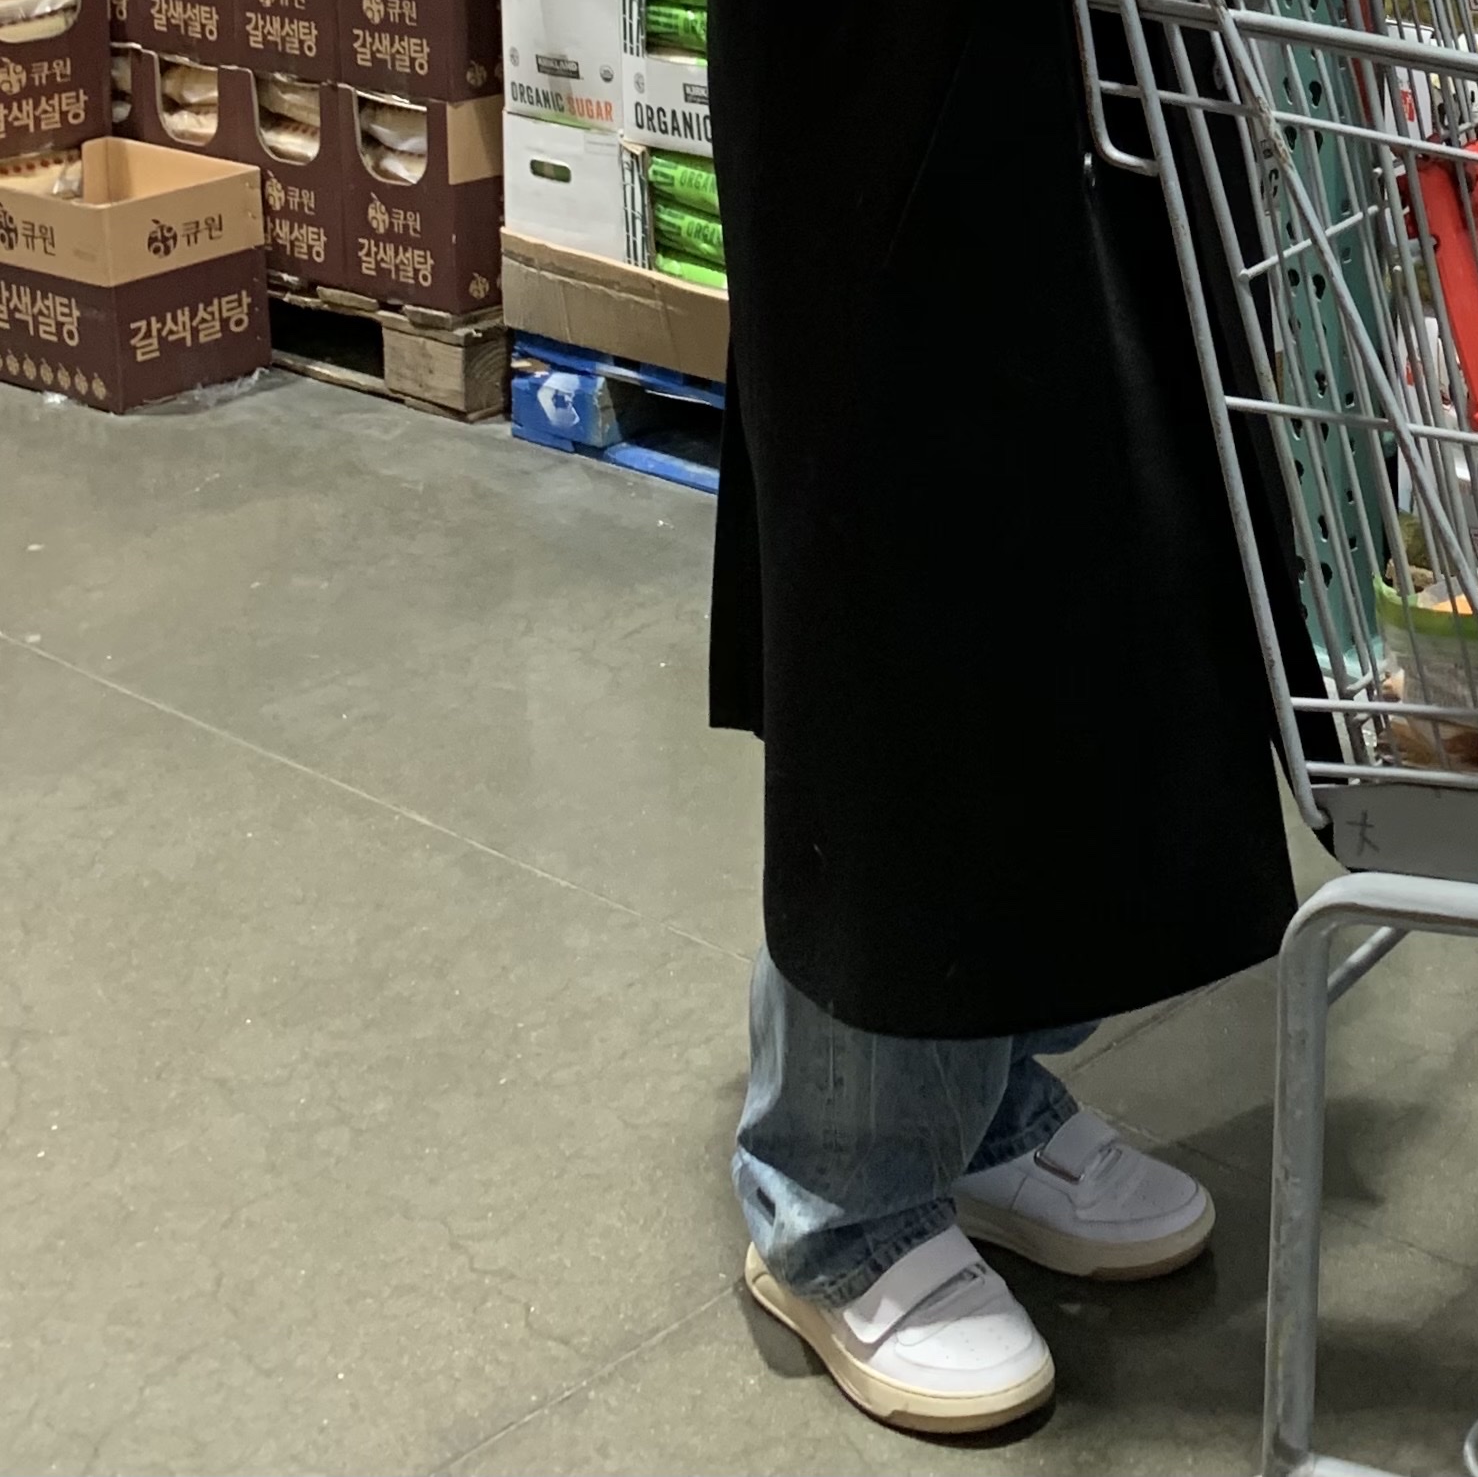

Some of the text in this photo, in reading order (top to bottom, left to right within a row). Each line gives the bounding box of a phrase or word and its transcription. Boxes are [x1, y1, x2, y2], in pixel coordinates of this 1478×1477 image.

[245, 12, 318, 57] 갈색설탕
[352, 28, 430, 76] 갈색설탕
[30, 56, 72, 87] 큐원
[510, 80, 613, 122] ORGANIC SUGAR
[634, 101, 710, 142] ORGANIC
[287, 188, 316, 216] 큐원
[391, 207, 422, 238] 큐원
[21, 221, 57, 257] 큐원
[180, 214, 224, 249] 큐원
[357, 238, 435, 288] 갈색설탕
[130, 290, 252, 363] 갈색설탕
